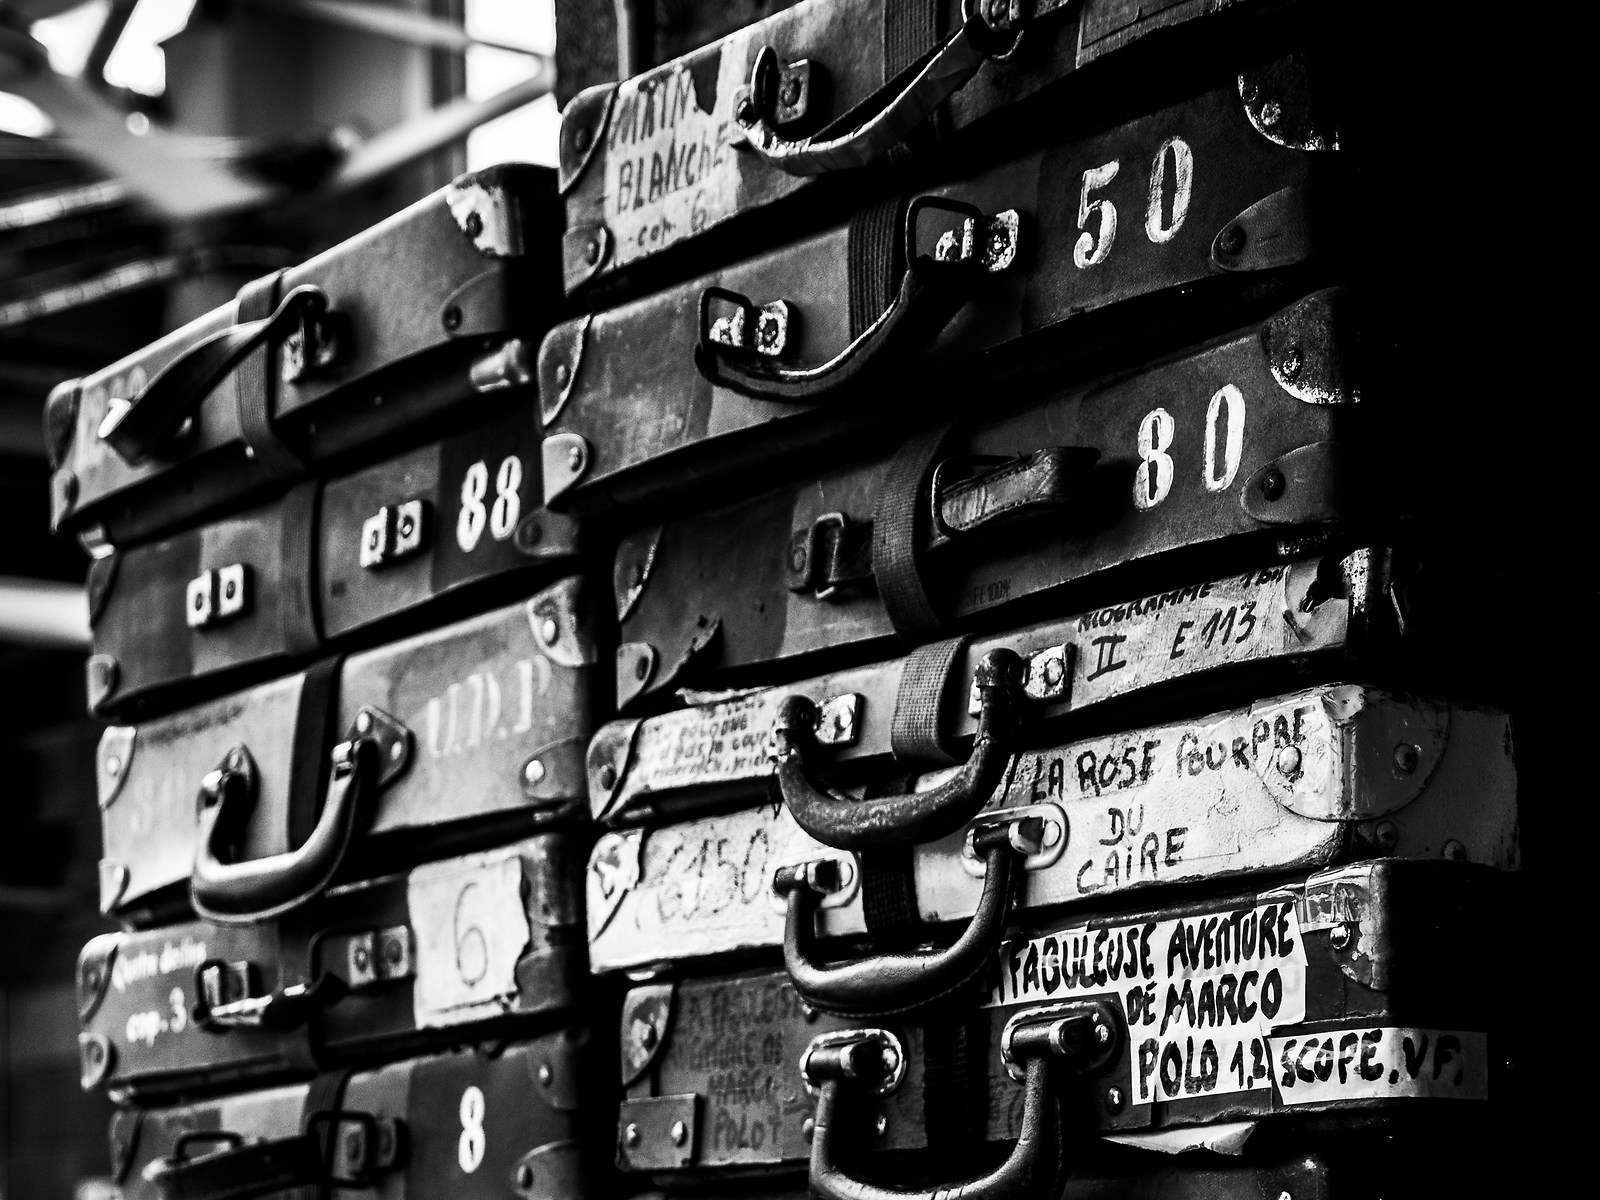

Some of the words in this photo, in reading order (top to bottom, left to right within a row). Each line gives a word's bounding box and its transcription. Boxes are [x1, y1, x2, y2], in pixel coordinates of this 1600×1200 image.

[1073, 135, 1194, 268] 50
[1133, 383, 1247, 511] 80
[456, 455, 522, 553] 88
[1031, 755, 1064, 802] LA
[1076, 737, 1161, 798] ROSE
[1100, 803, 1144, 846] DU
[453, 880, 488, 988] 6
[1009, 922, 1156, 998] FABULEUSE
[1167, 901, 1296, 979] AVENTURE
[1159, 968, 1282, 1036] MARCO
[1138, 1036, 1219, 1100] POLO
[457, 1086, 486, 1173] 8
